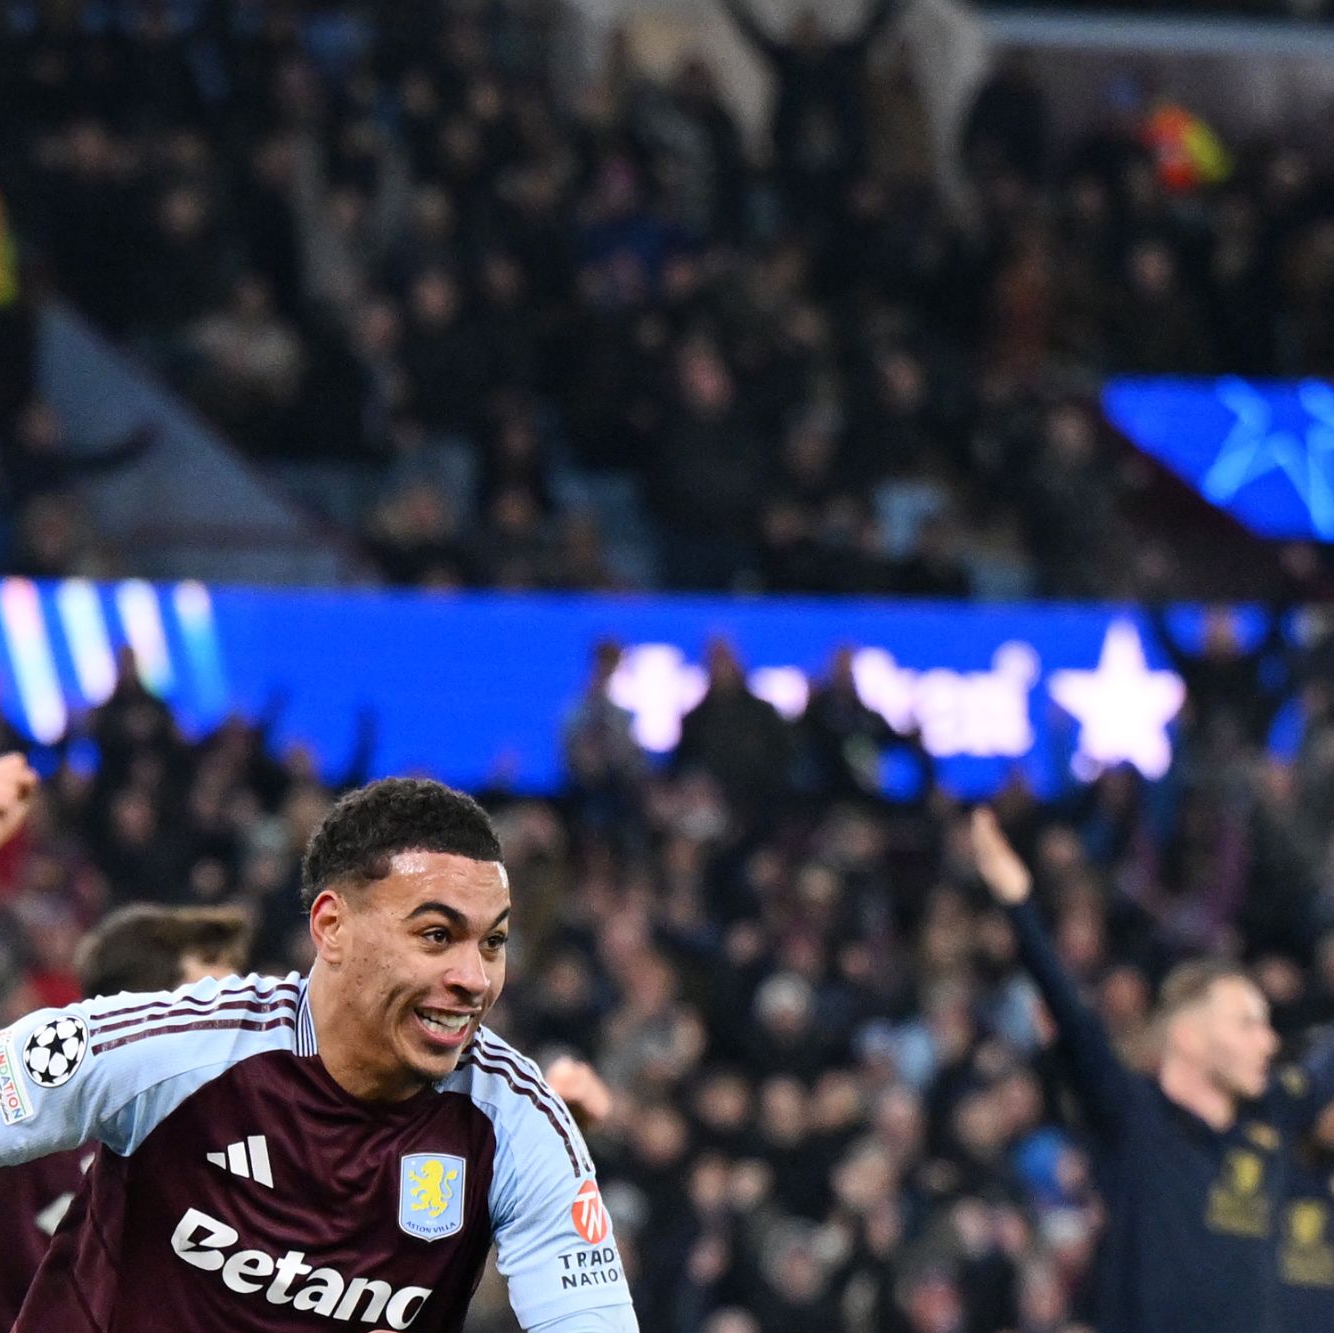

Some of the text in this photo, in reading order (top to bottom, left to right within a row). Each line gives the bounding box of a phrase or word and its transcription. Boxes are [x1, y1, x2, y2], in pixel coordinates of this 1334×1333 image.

[406, 1221, 432, 1233] ASTON
[433, 1221, 456, 1233] VILLA
[170, 1207, 433, 1330] Betano
[558, 1247, 616, 1269] TRAD
[561, 1268, 620, 1289] NATIO
